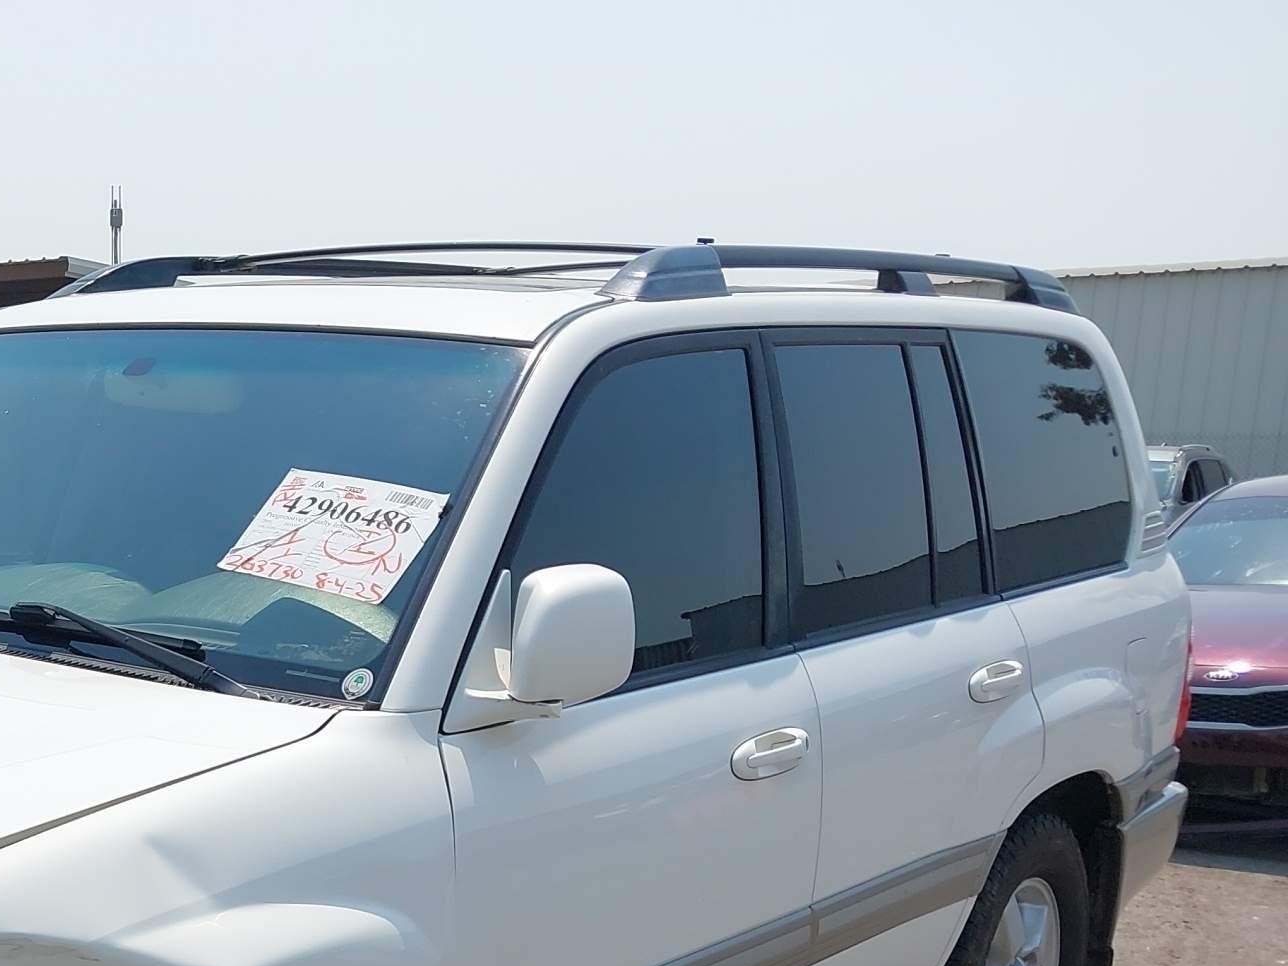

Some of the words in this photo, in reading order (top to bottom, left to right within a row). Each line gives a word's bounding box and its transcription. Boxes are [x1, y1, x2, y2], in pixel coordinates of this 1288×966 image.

[283, 494, 412, 535] 42906486
[225, 554, 303, 580] 263730
[315, 572, 384, 602] 8-4-25
